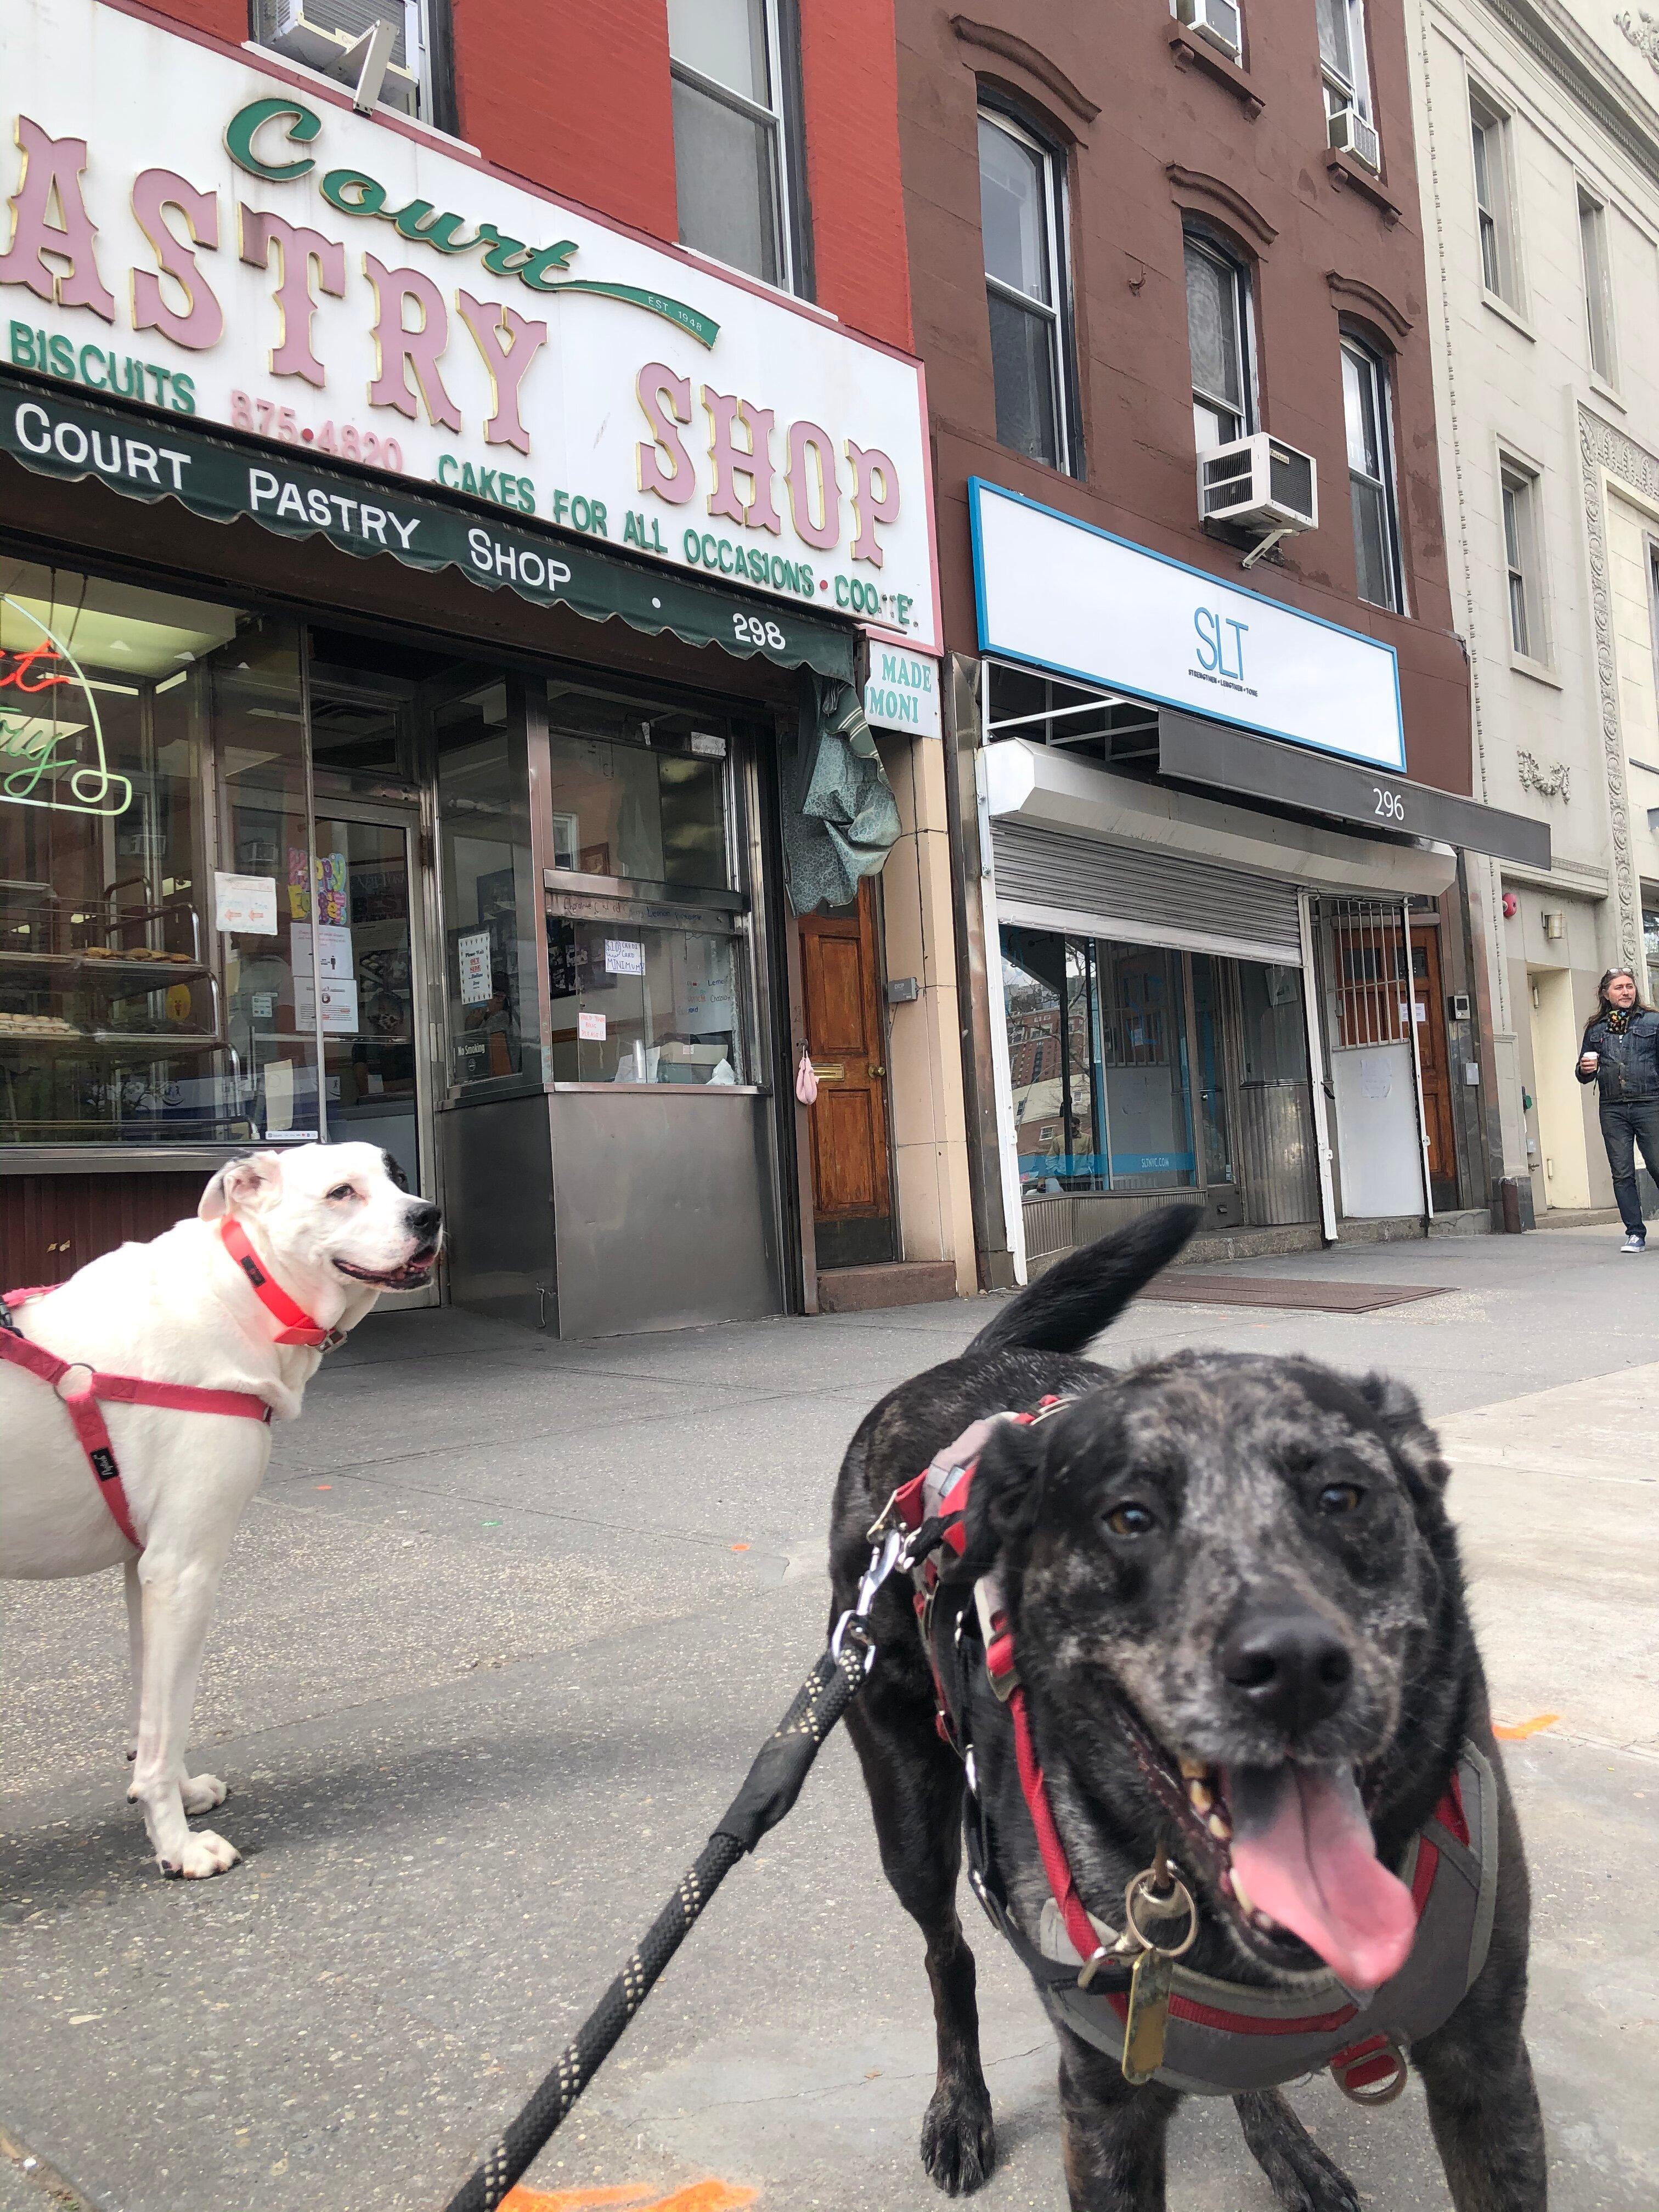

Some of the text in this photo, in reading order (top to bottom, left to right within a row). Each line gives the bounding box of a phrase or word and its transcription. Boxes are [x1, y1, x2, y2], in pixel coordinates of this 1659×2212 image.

[223, 98, 579, 292] Court
[678, 311, 702, 332] 1948
[9, 320, 196, 416] BISCUITS
[636, 362, 901, 568] SHOP
[15, 403, 786, 651] COURT PASTRY SHOP 298
[439, 454, 535, 515] CAKES
[553, 489, 607, 538] FOR
[623, 510, 668, 554] ALL
[684, 528, 815, 597] OCCASIONS
[1194, 607, 1249, 681] SLT
[882, 653, 932, 693] MADE
[1188, 669, 1258, 697] STRENGTHEN LENGTHEN TONE
[1374, 787, 1405, 821] 296
[607, 940, 619, 952] $10
[458, 1043, 485, 1056] No Smoking
